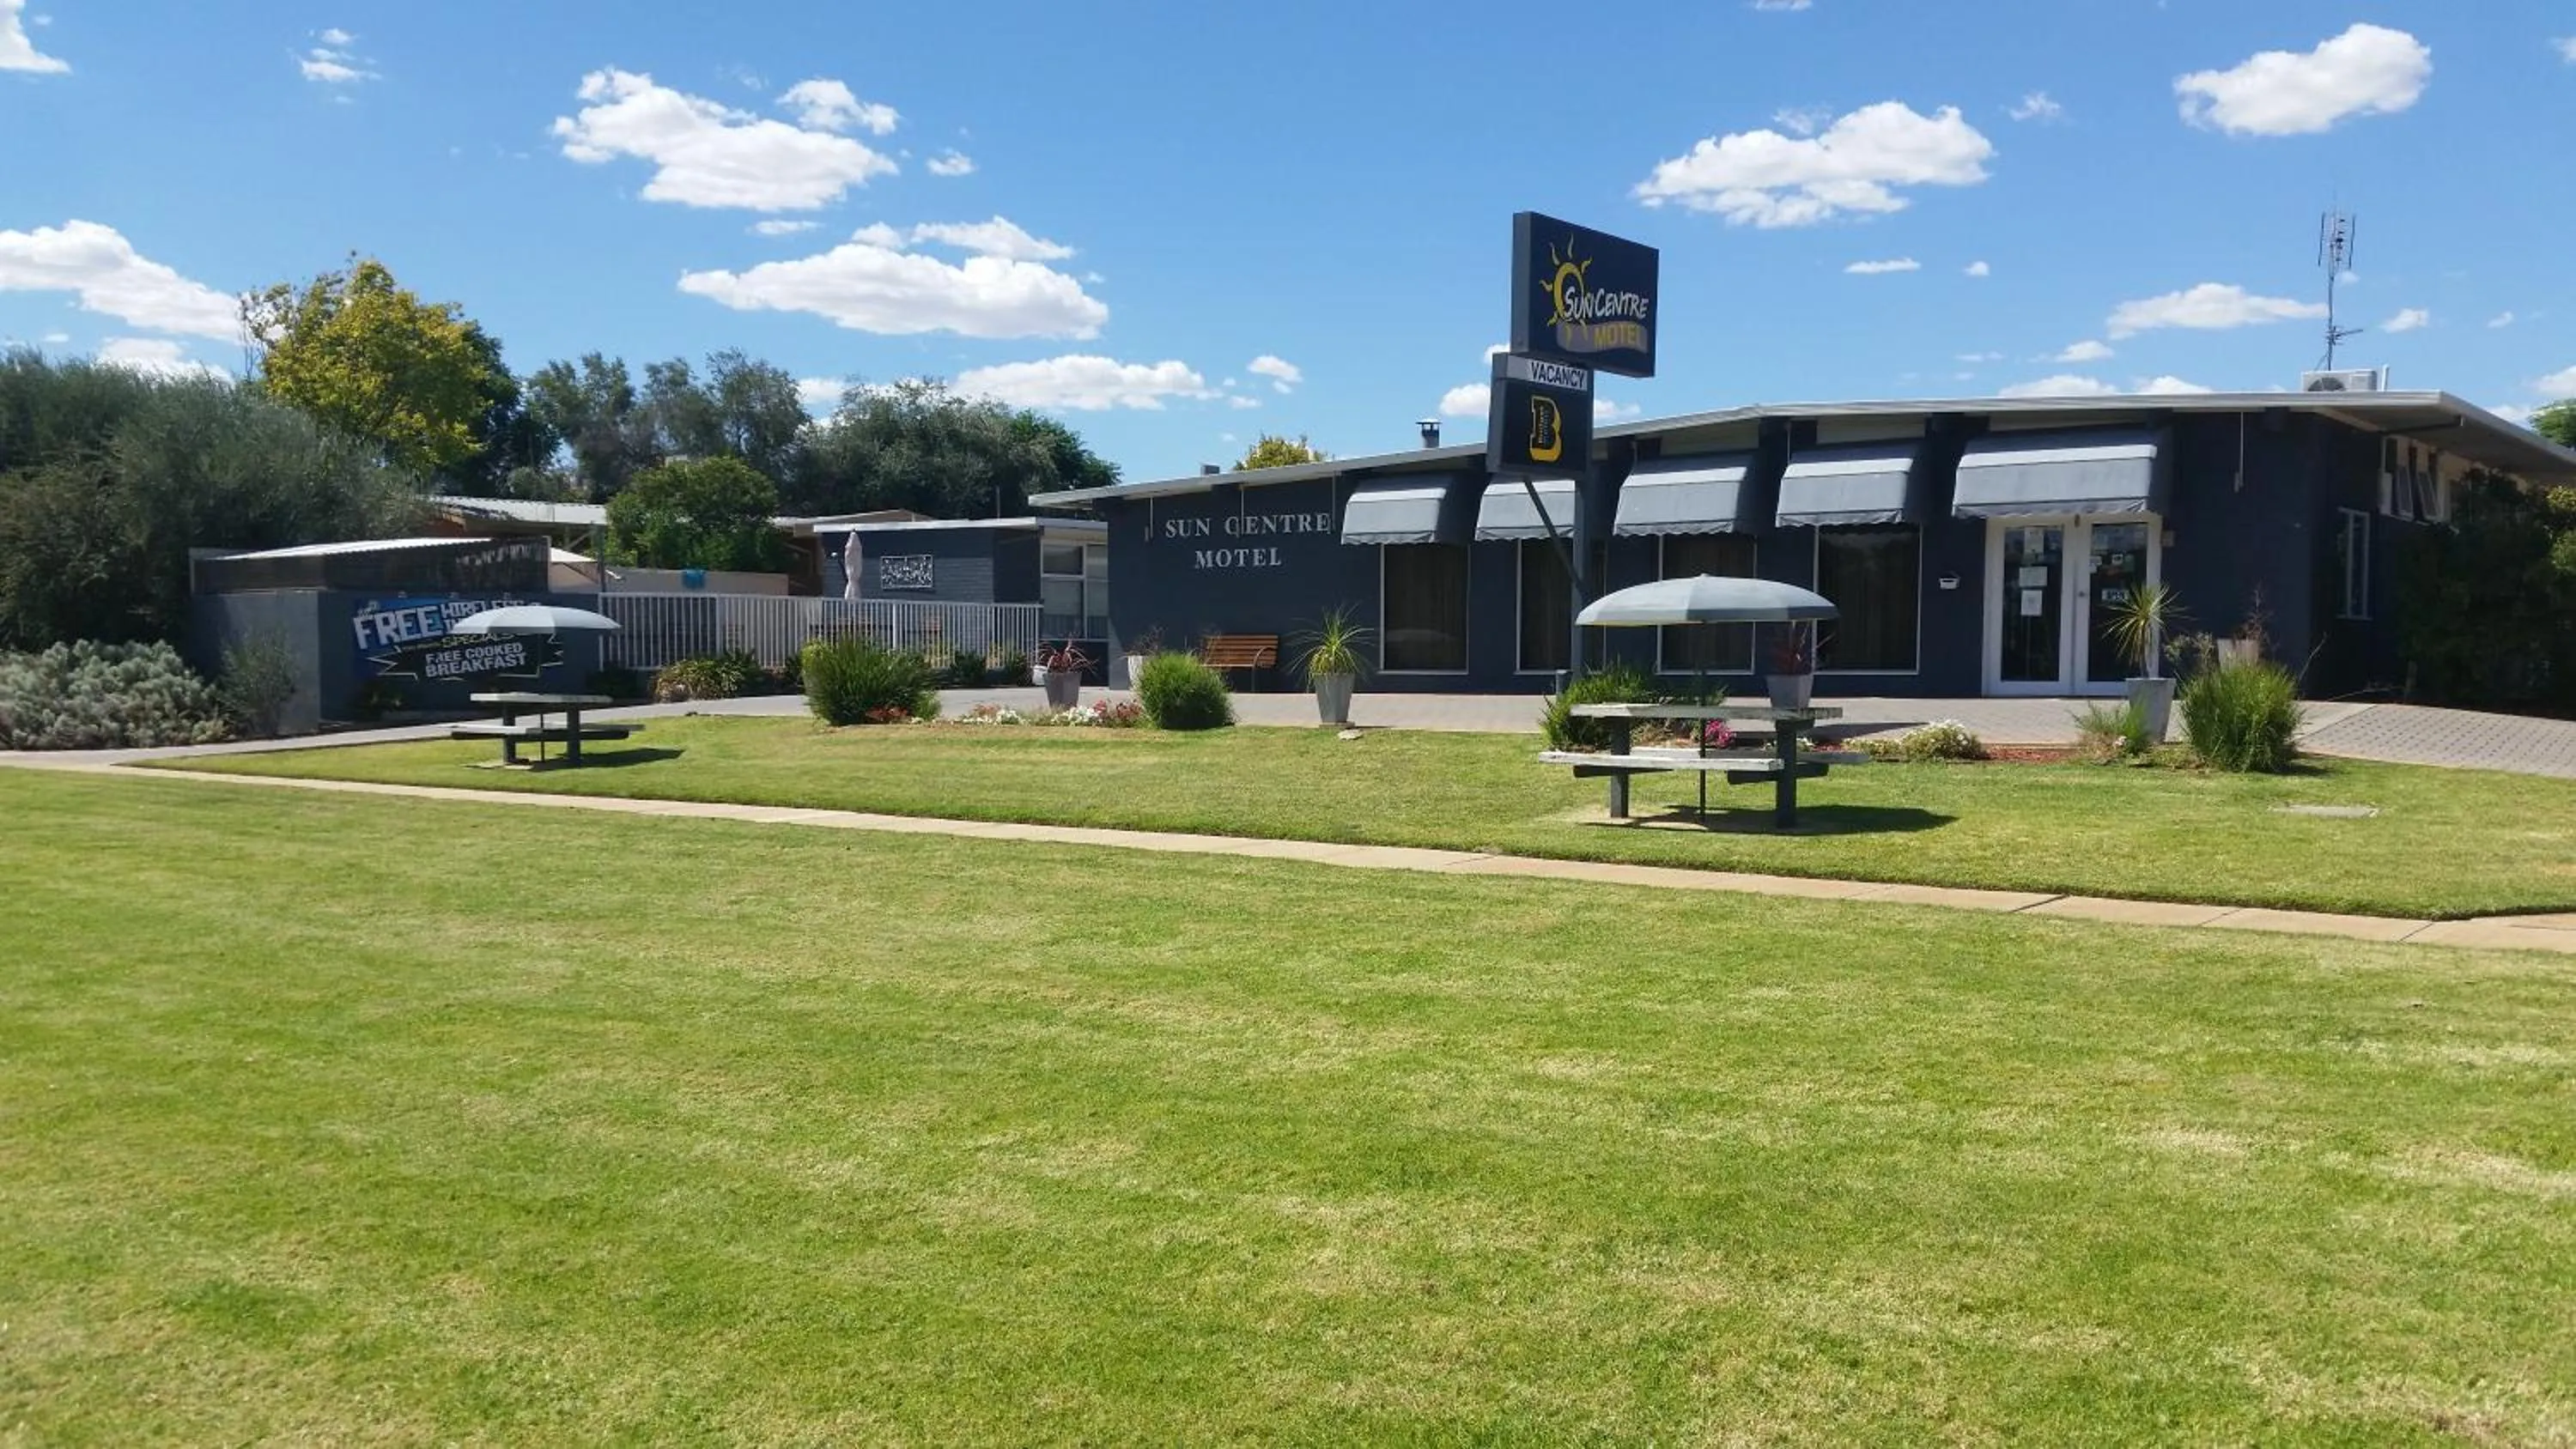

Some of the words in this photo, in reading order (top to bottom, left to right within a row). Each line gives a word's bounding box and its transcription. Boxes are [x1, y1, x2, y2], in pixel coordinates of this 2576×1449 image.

[1594, 323, 1643, 349] MOTEL
[1531, 361, 1584, 388] VACANCY
[1165, 518, 1212, 538] SUN
[1224, 512, 1331, 537] CENTRE
[1194, 547, 1282, 568] MOTEL
[353, 605, 444, 650] FREE
[425, 652, 526, 676] BREAKFAST
[426, 650, 462, 664] FREE
[465, 642, 523, 659] COOKED
